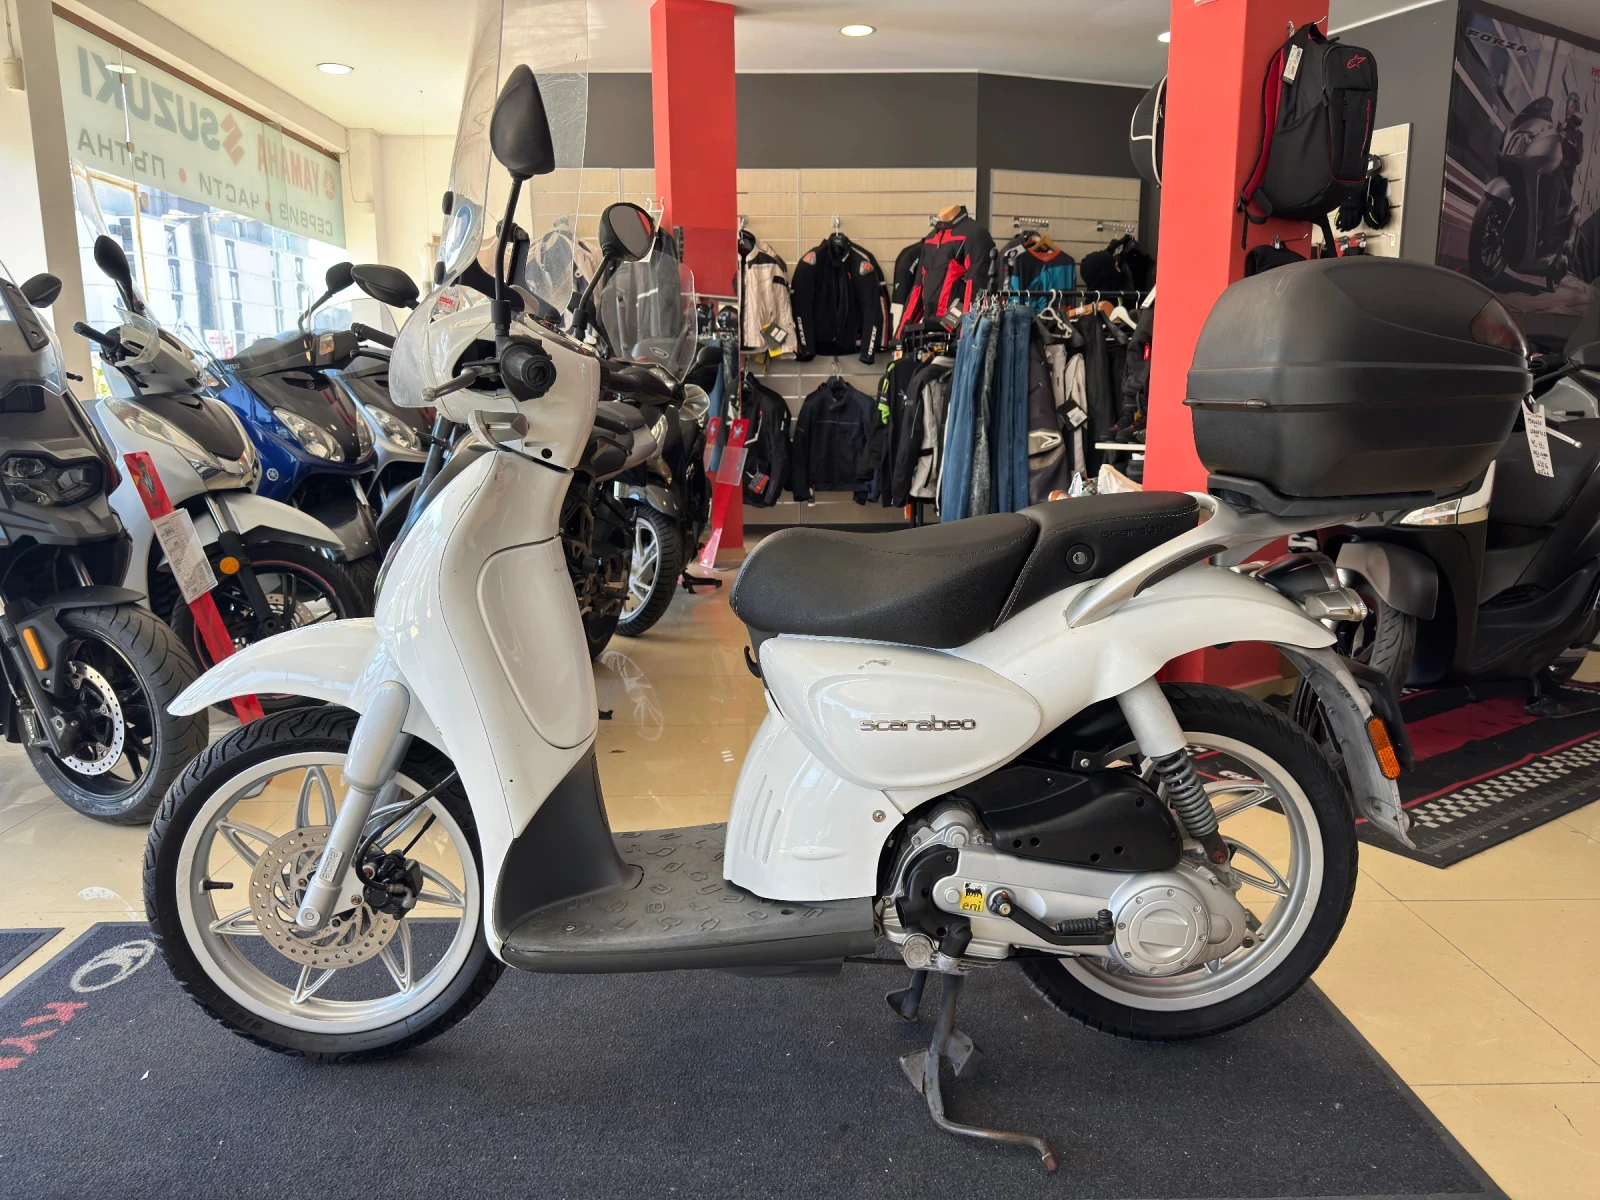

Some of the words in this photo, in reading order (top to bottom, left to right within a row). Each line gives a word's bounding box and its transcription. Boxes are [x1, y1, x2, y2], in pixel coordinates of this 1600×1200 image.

[1466, 27, 1528, 53] FORZA
[1100, 523, 1176, 539] scarabeo
[859, 714, 977, 731] scarabeo
[962, 900, 982, 912] eni
